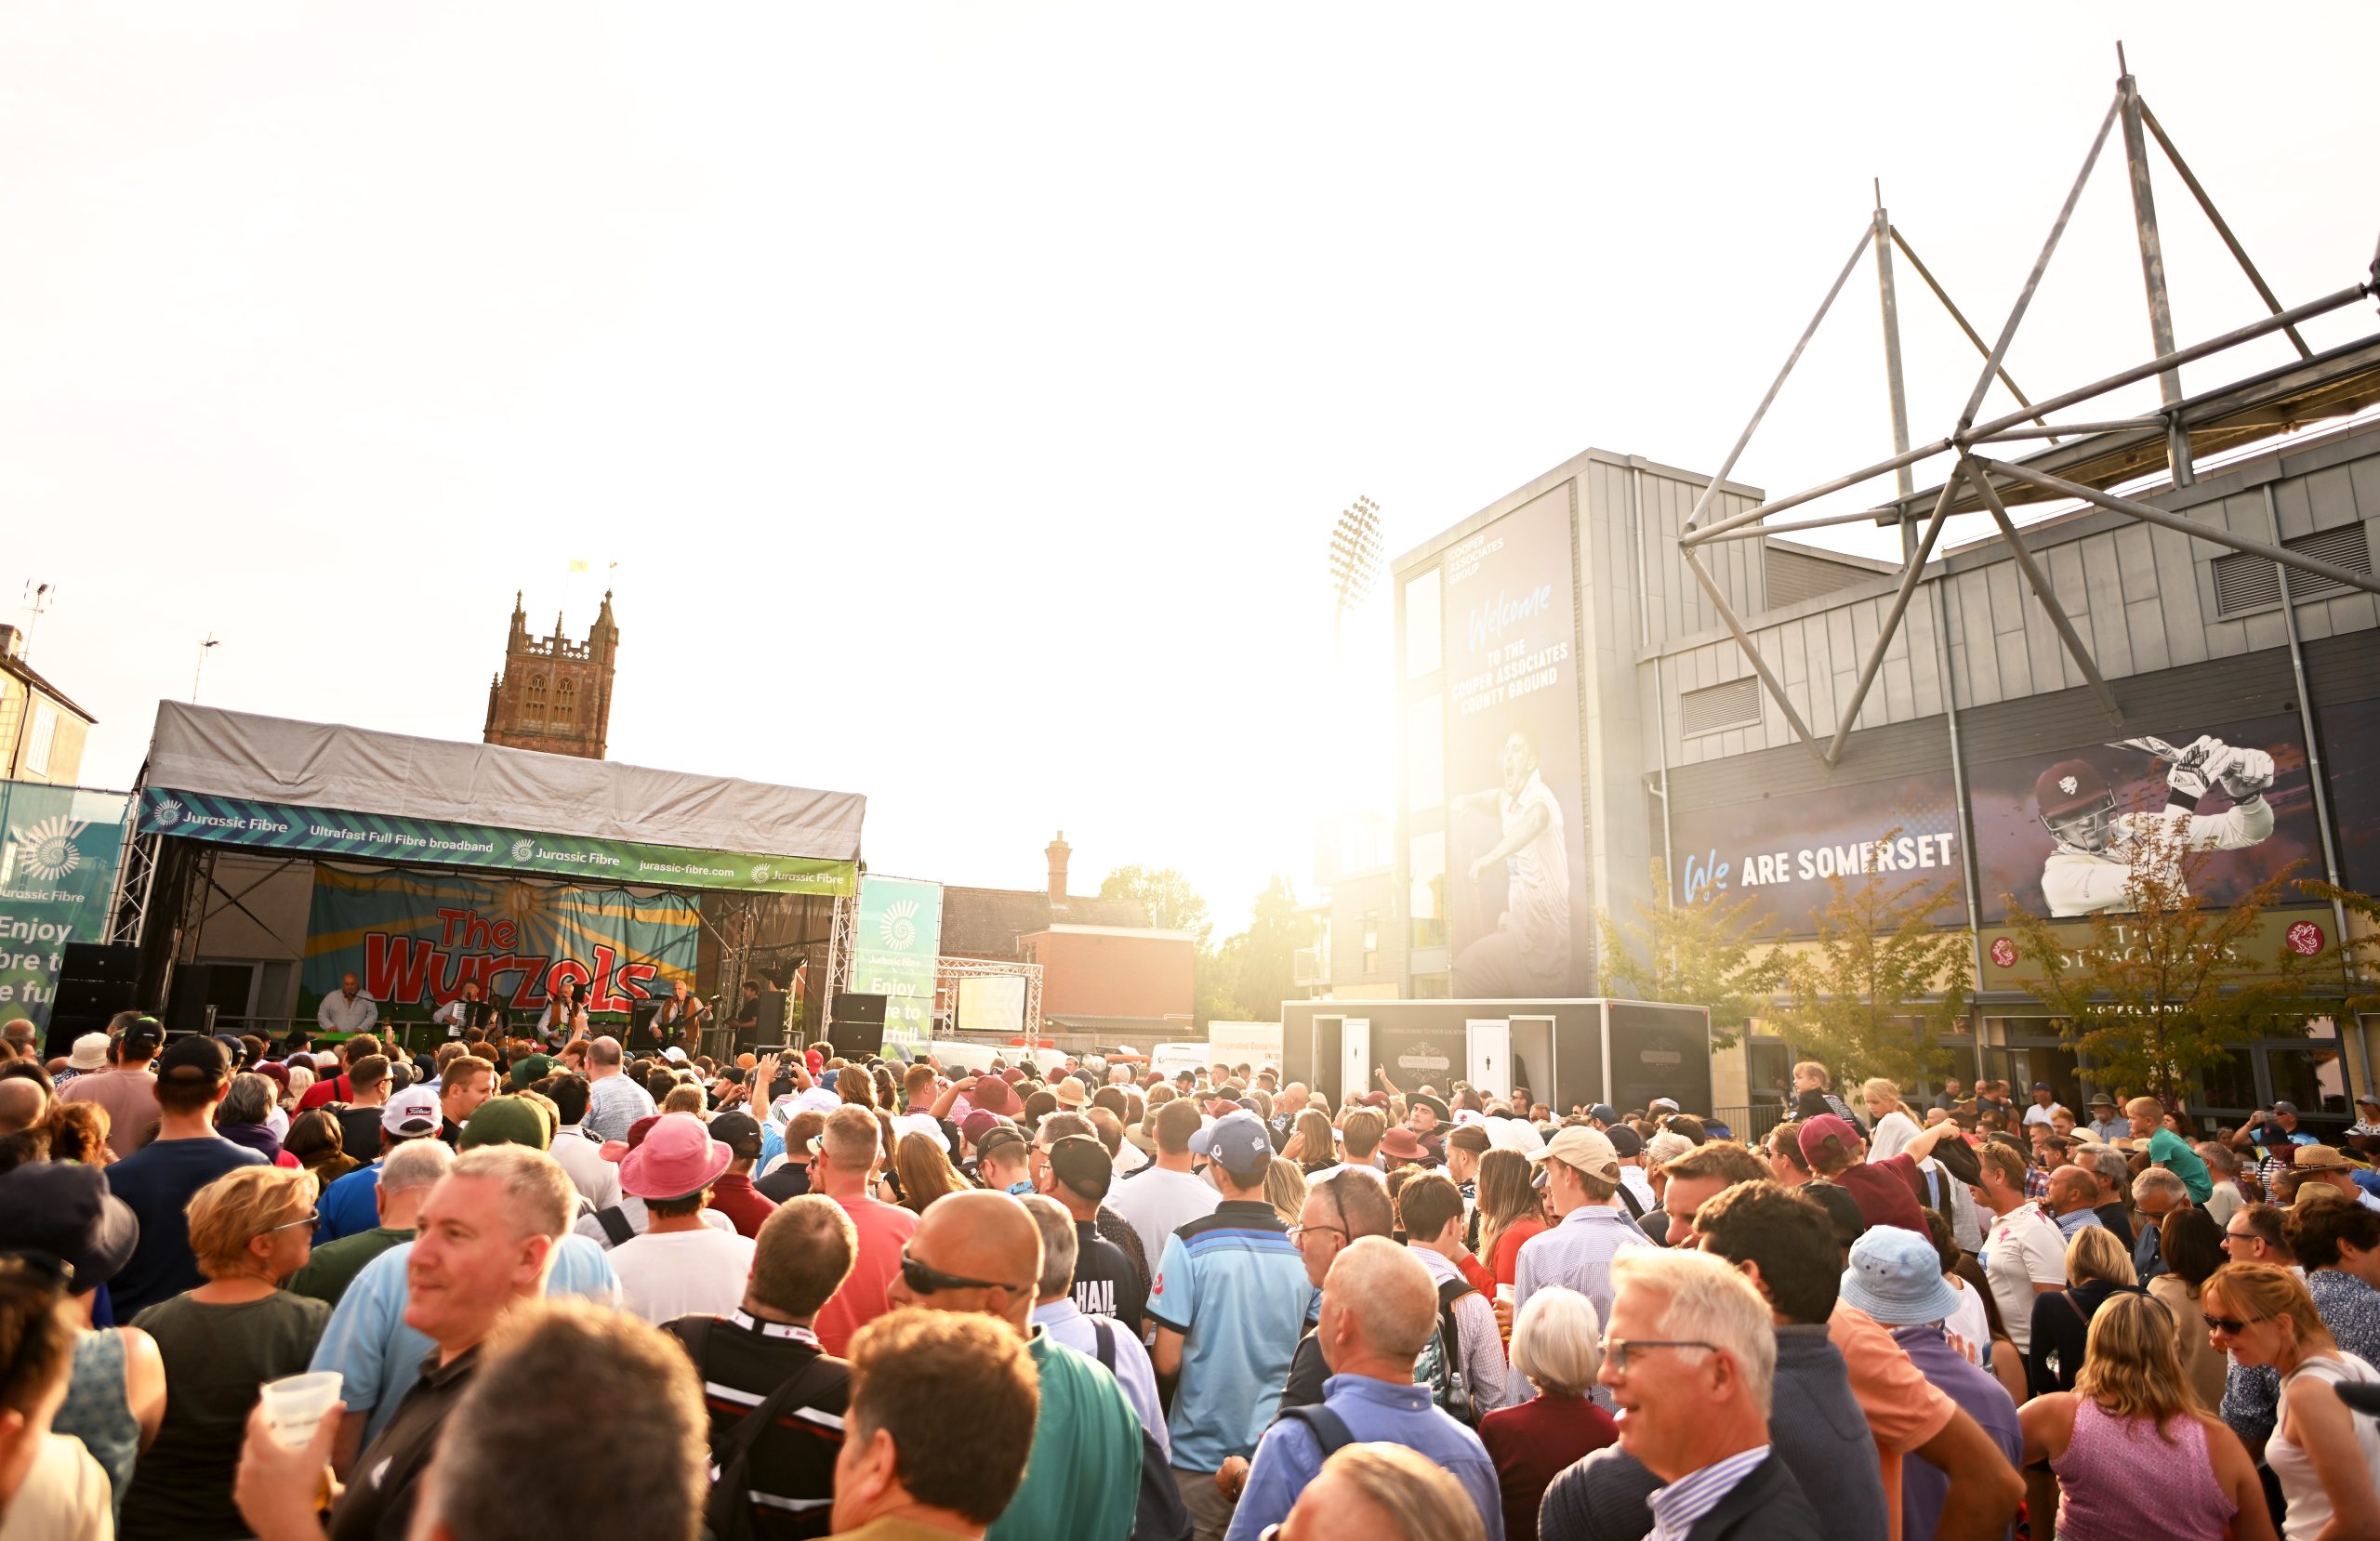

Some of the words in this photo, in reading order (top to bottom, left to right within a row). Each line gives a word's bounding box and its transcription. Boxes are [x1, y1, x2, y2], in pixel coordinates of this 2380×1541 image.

[1448, 534, 1485, 561] COOPER
[1449, 538, 1503, 574] ASSOCIATES
[1449, 562, 1480, 586] GROUP
[1468, 583, 1553, 652] Welcome
[1488, 650, 1501, 667] TO
[1505, 639, 1526, 661] THE
[1451, 672, 1493, 700] COOPER
[1497, 641, 1568, 685] ASSOCIATES
[1461, 686, 1503, 716] COUNTY
[1509, 666, 1558, 700] GROUND
[183, 811, 246, 829] Jurassic
[249, 818, 288, 833] Fibre
[311, 824, 365, 841] Ultrafast
[369, 831, 392, 843] Full
[395, 835, 427, 847] Fibre
[430, 837, 494, 853] broadband
[536, 848, 587, 863] Jurassic
[588, 853, 620, 866] Fibre
[639, 860, 734, 877] jurassic-fibre.com
[1685, 849, 1729, 904] We
[1741, 852, 1790, 887] ARE
[1798, 832, 1953, 880] SOMERSET
[772, 870, 815, 882] Jurassic
[817, 875, 844, 884] Fibre
[0, 889, 48, 901] urassic
[51, 890, 85, 902] Fibre
[0, 915, 73, 946] Enjoy
[437, 907, 519, 950] The
[49, 952, 64, 972] t
[364, 932, 657, 1014] Wurzels
[22, 981, 59, 1004] ful
[872, 977, 916, 1000] Enjoy
[905, 1005, 920, 1021] to
[892, 1026, 919, 1042] full
[1076, 1279, 1117, 1312] HAIL
